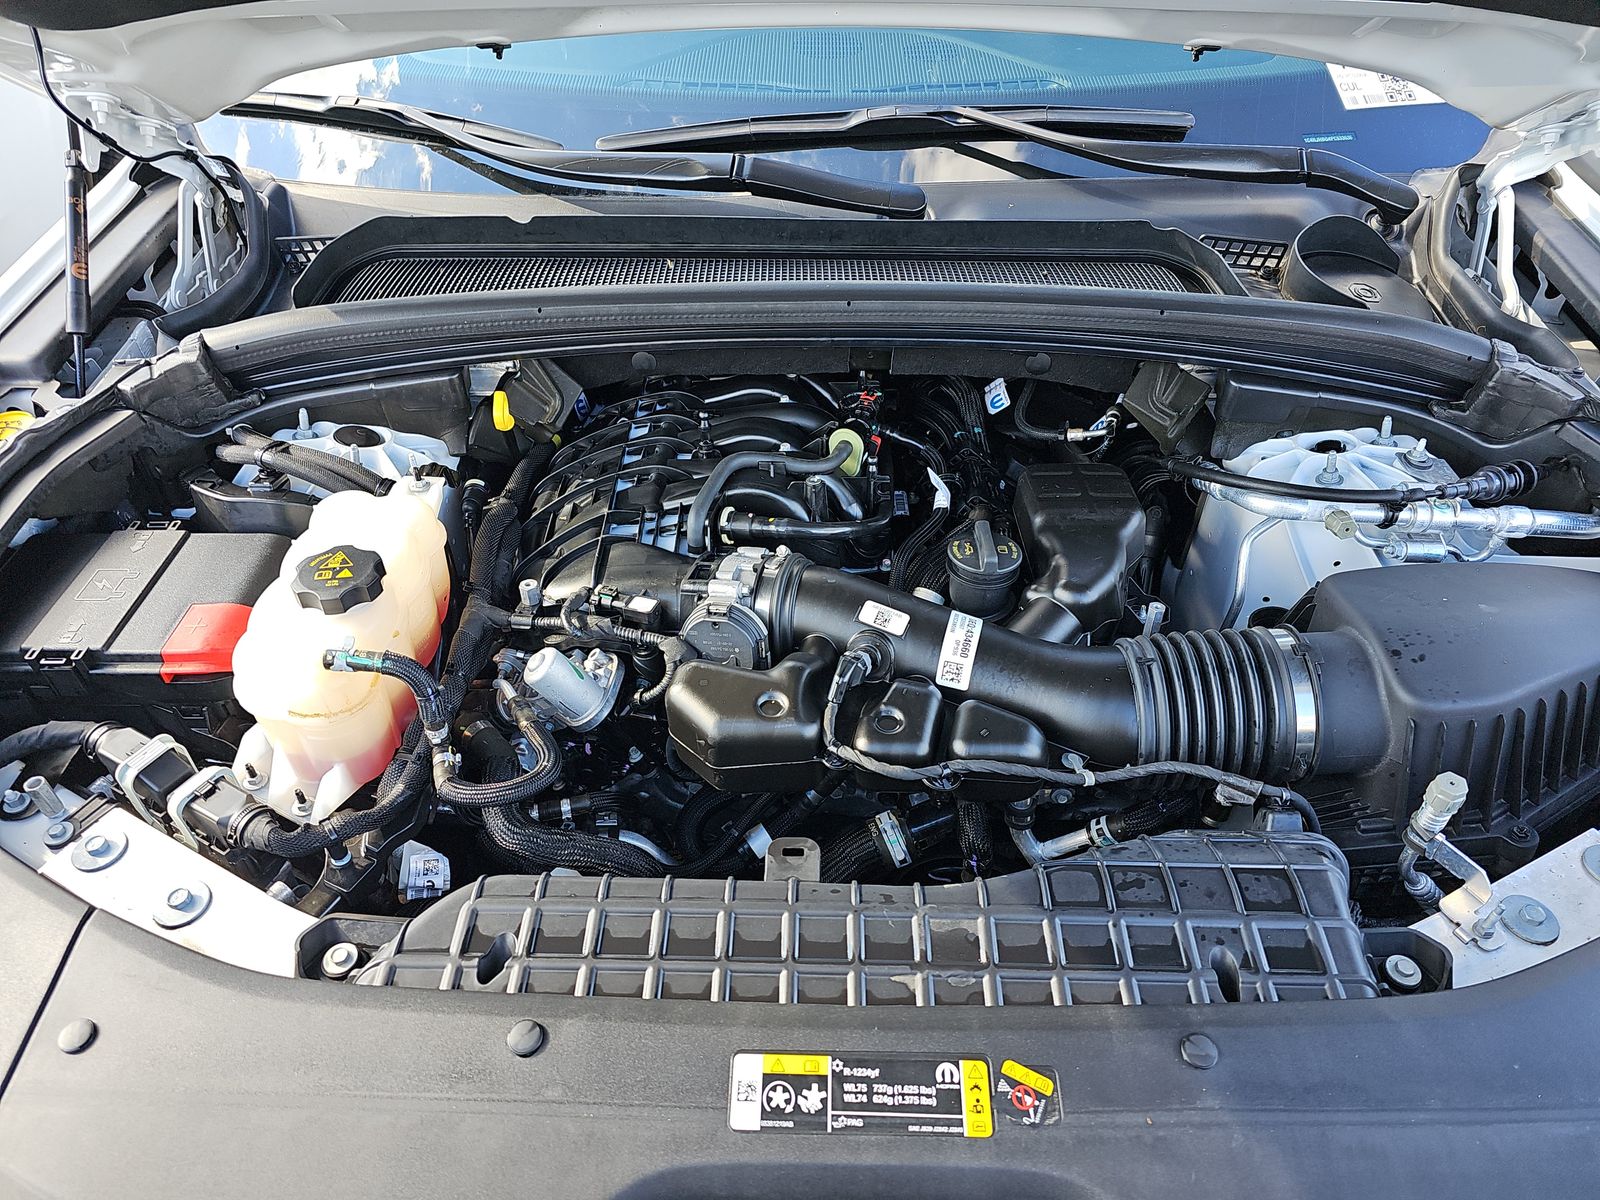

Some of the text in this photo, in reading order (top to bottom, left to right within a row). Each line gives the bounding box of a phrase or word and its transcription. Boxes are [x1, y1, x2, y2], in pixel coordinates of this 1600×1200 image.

[868, 822, 879, 836] ENG
[843, 1067, 880, 1078] R-1234yf
[843, 1083, 936, 1095] WL75 737g (1.625 lbs)
[843, 1094, 937, 1106] WL74 624g (1.375 lbs)
[847, 1118, 863, 1127] PAG
